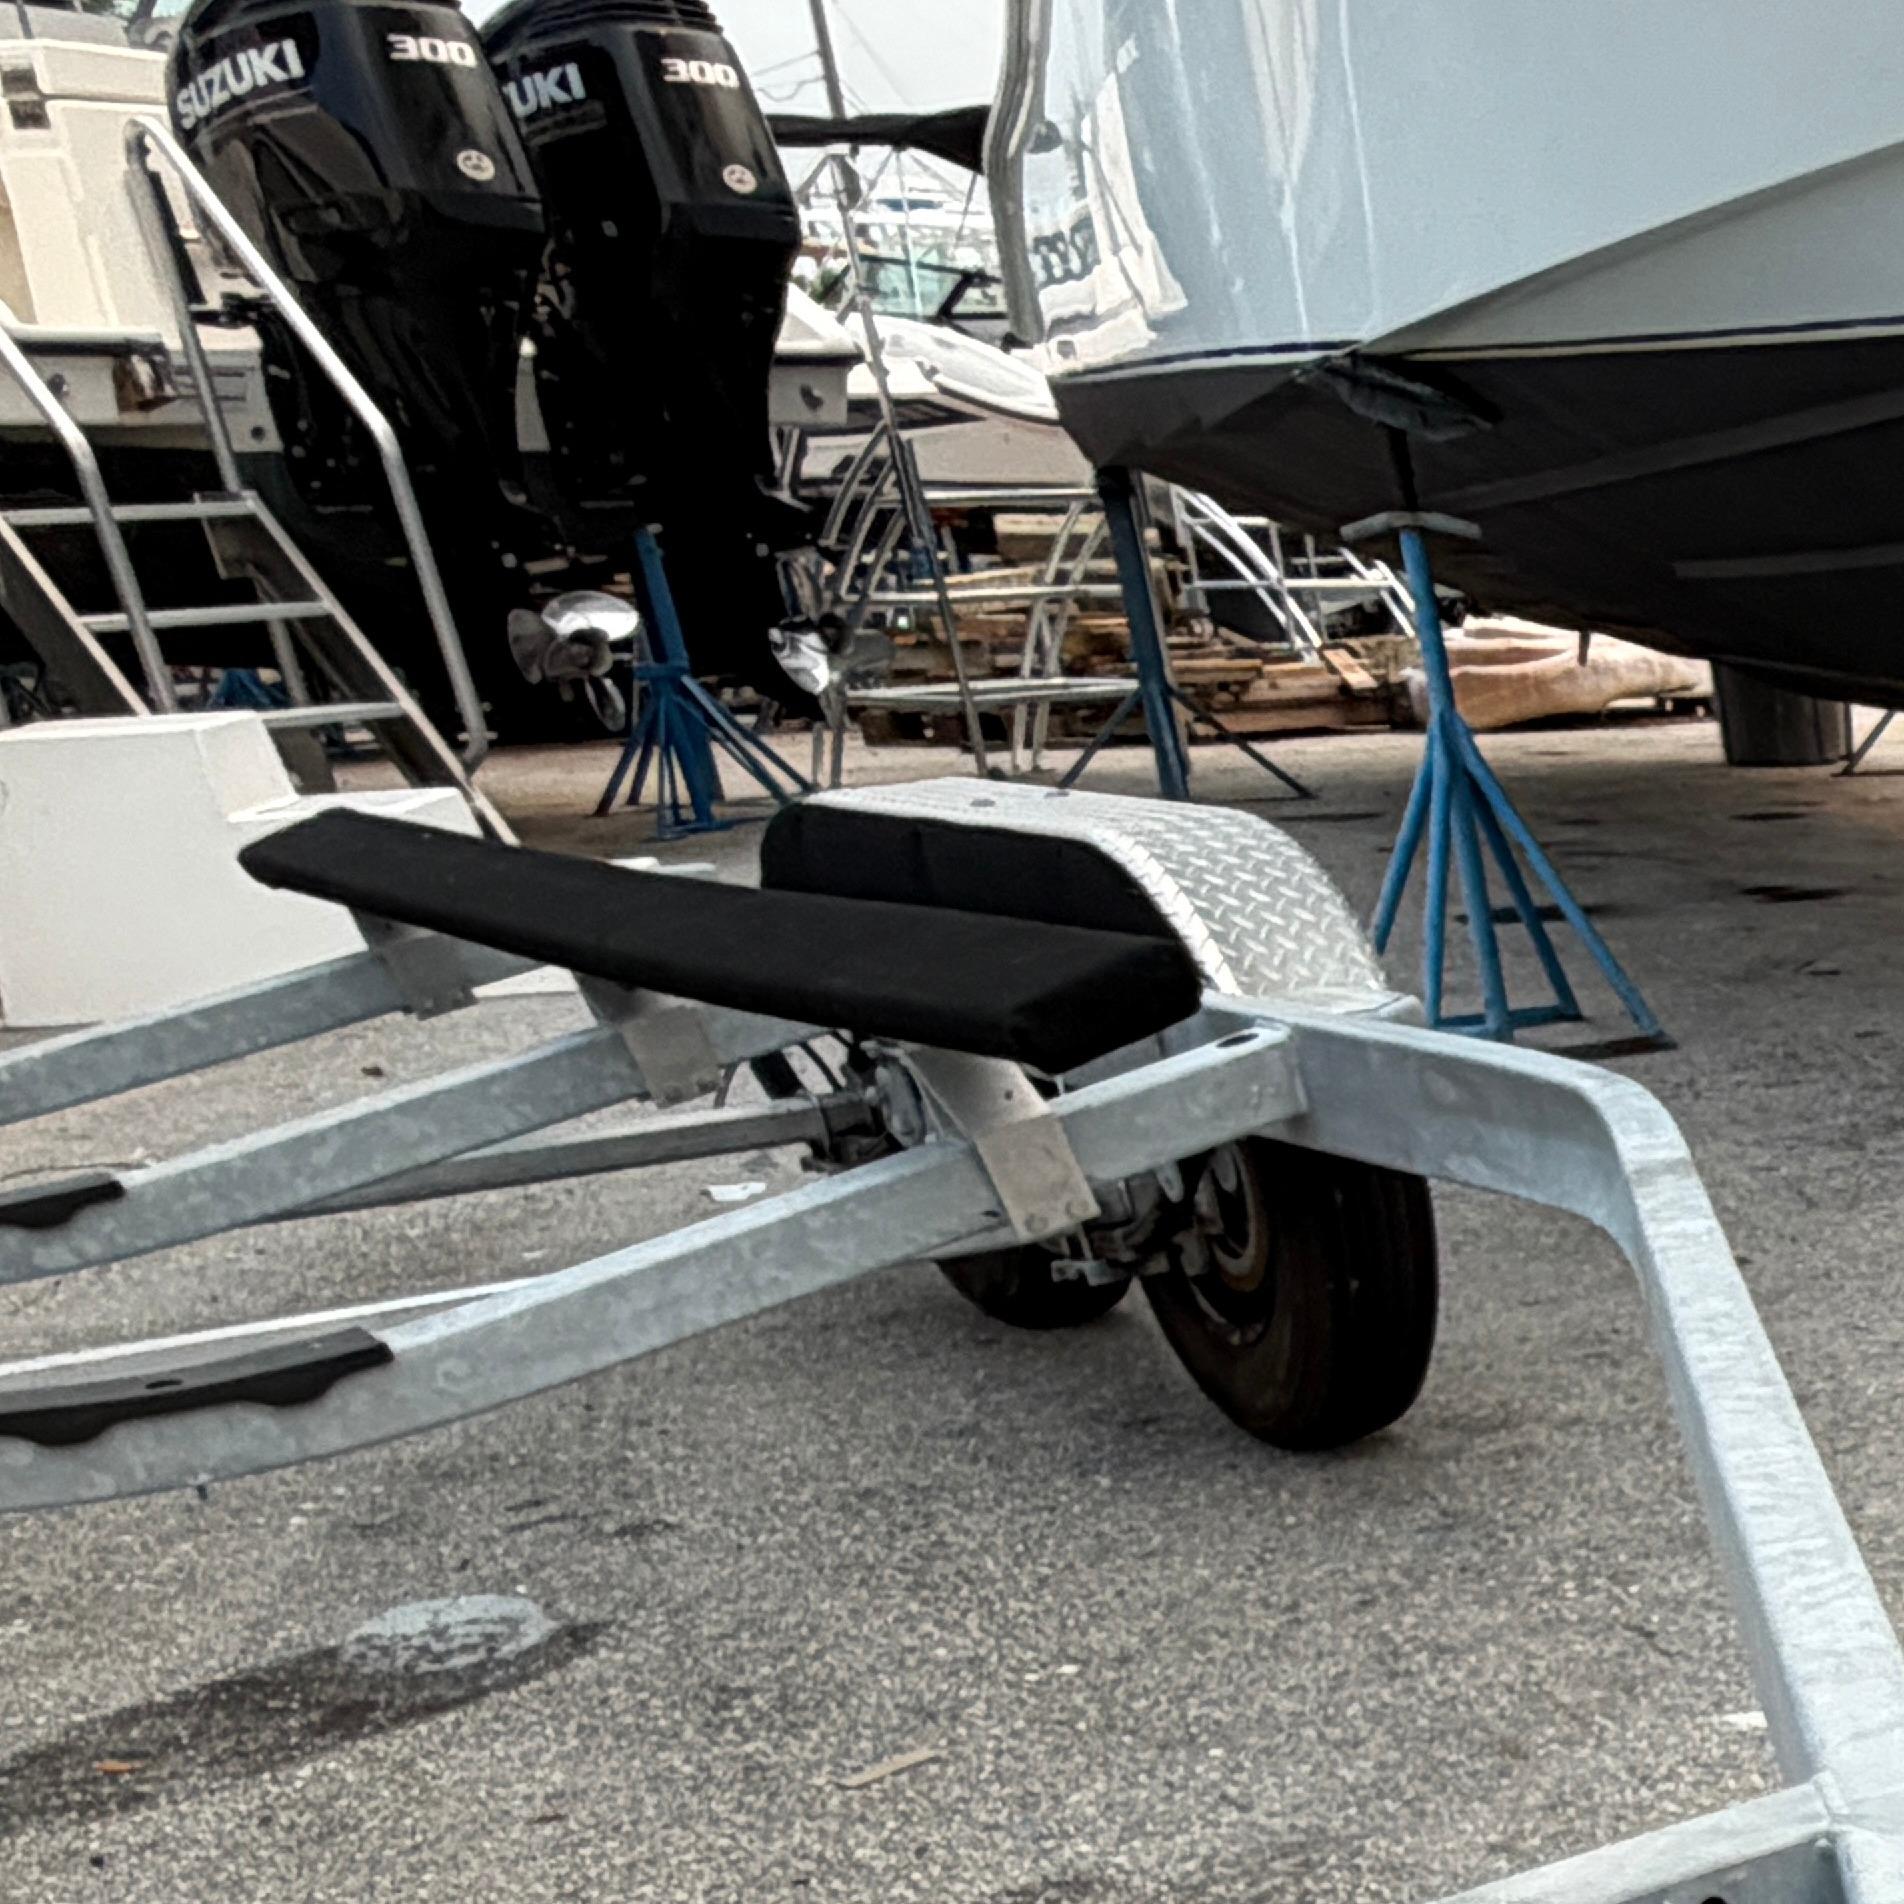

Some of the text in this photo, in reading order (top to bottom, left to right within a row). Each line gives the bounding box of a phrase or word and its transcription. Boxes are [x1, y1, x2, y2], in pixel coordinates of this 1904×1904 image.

[386, 34, 478, 68] 300
[660, 58, 740, 88] 300
[176, 38, 306, 130] SUZUKI
[502, 62, 587, 118] UKI
